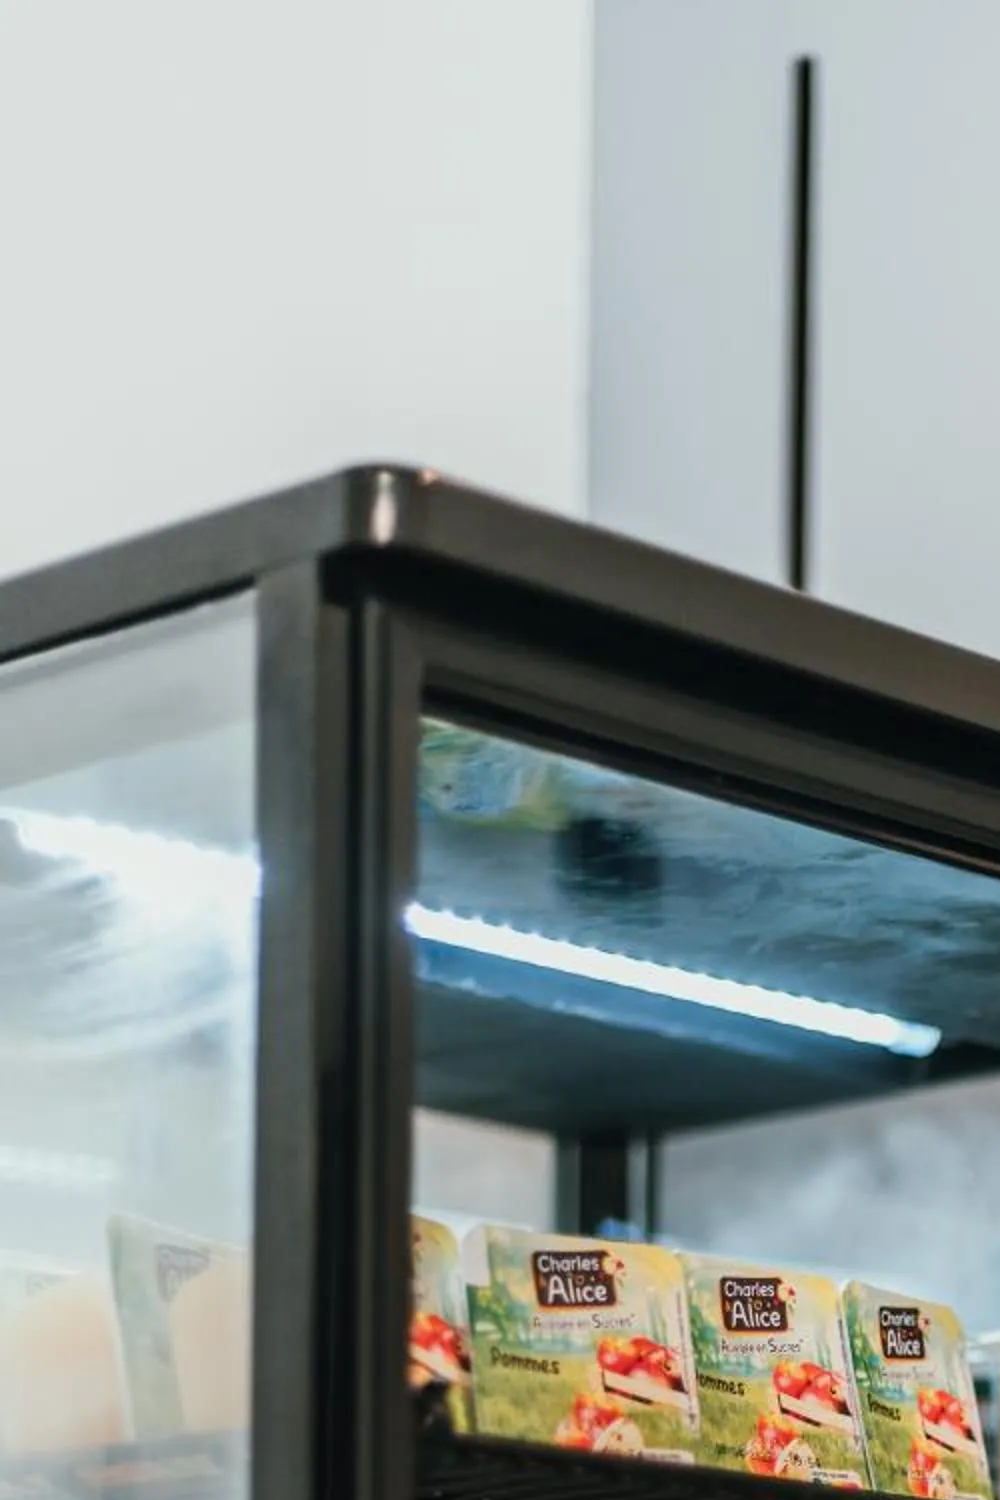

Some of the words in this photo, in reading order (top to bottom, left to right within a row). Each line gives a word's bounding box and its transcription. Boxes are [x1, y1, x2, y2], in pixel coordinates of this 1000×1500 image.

[537, 1255, 600, 1273] Charles
[547, 1274, 608, 1304] Alice
[724, 1281, 775, 1297] Charles
[731, 1300, 781, 1328] Alice
[695, 1368, 745, 1397] ommes
